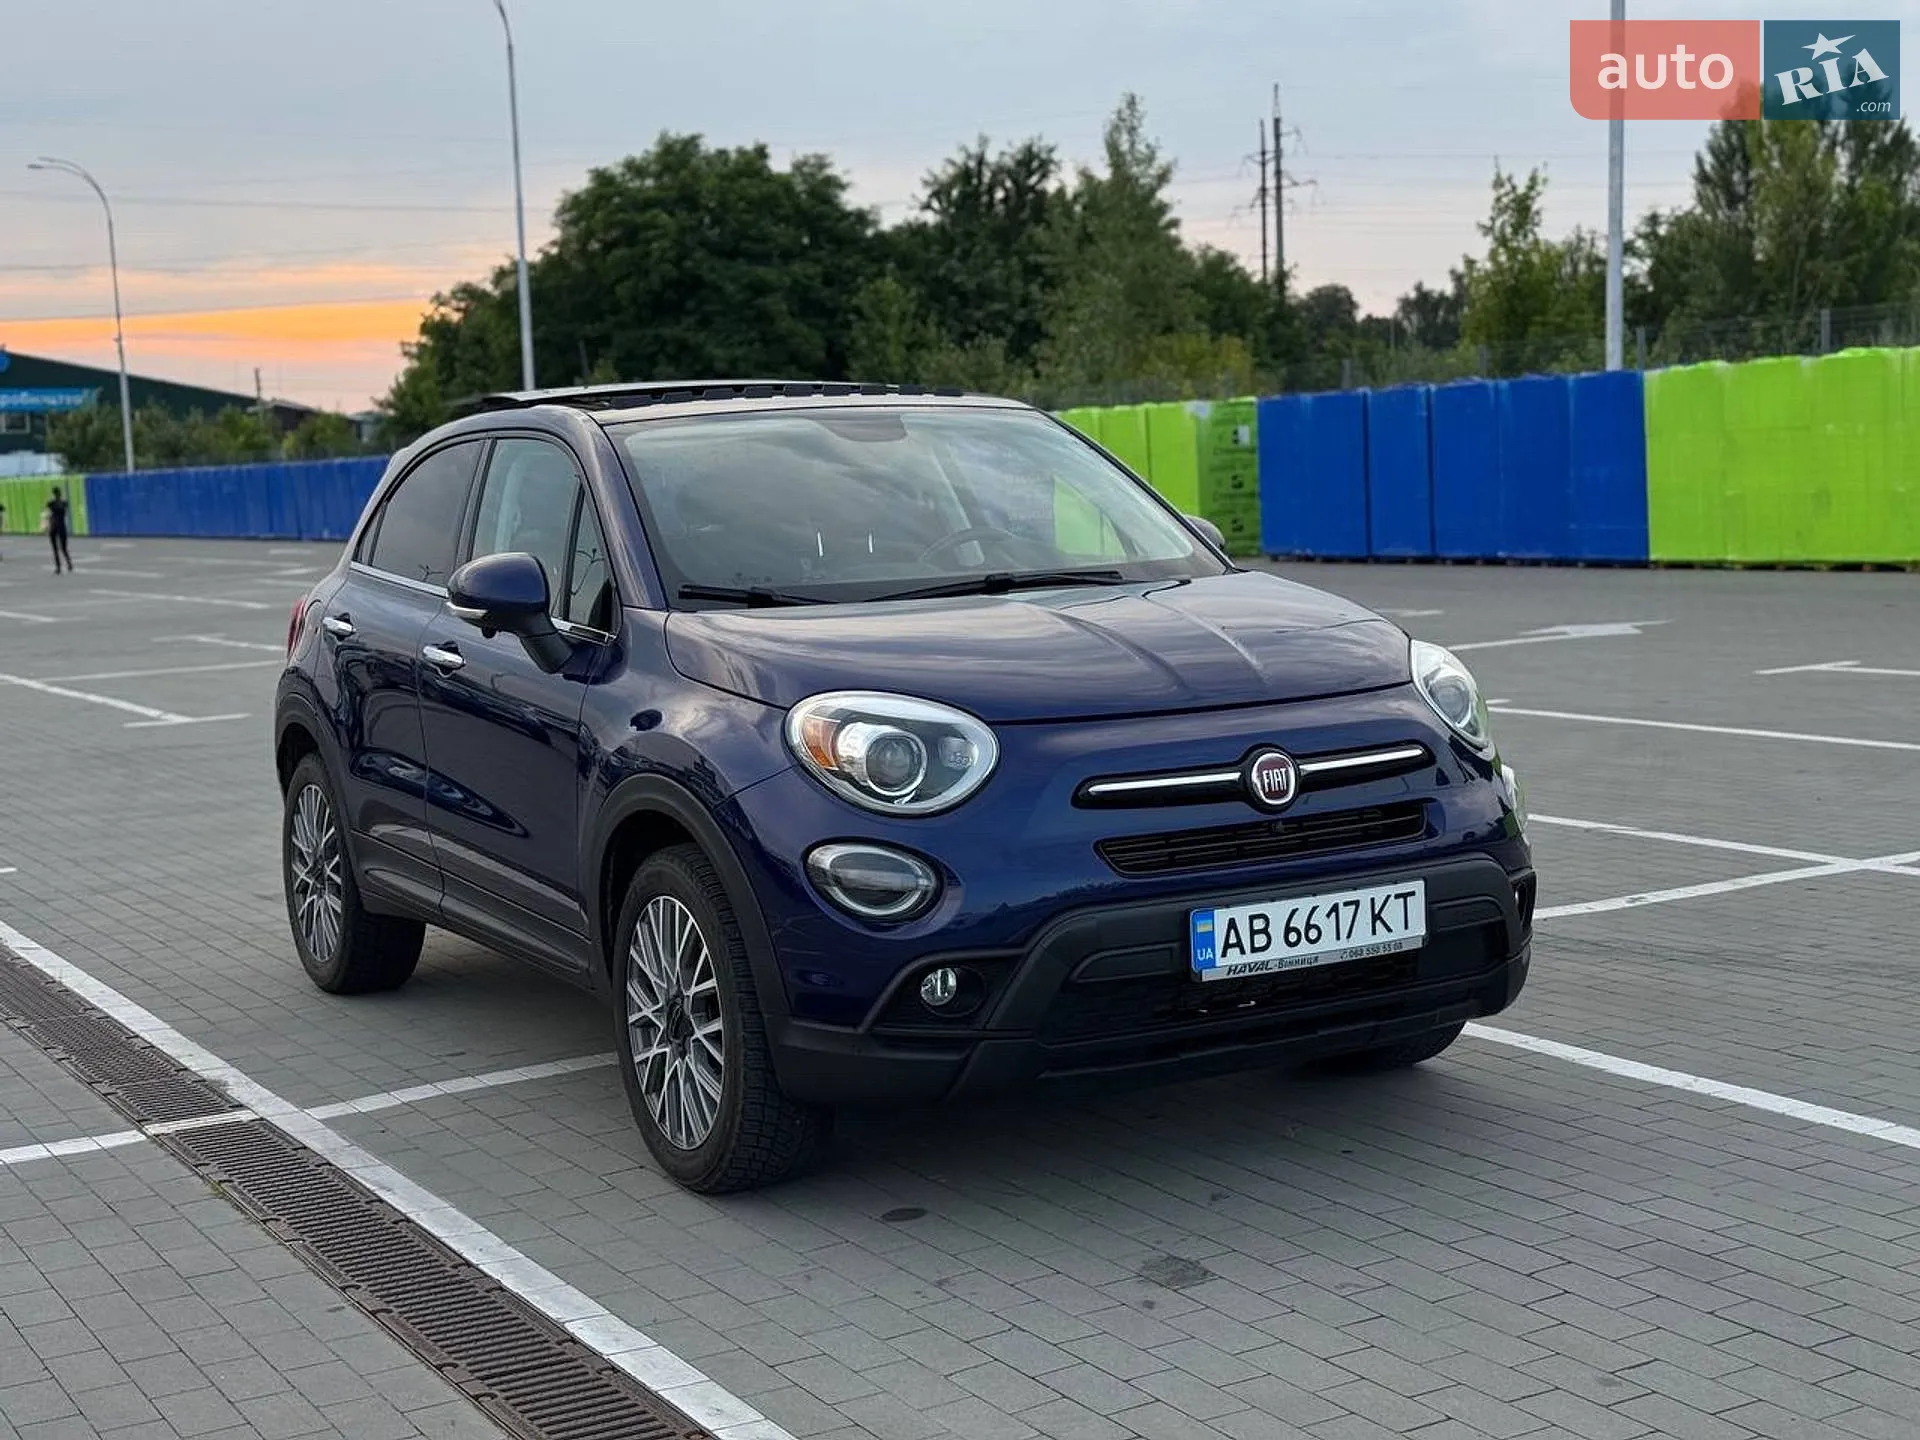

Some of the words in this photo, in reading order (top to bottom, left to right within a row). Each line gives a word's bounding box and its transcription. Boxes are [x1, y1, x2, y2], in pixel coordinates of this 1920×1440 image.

[1262, 767, 1287, 793] FIAT
[1221, 913, 1272, 958] AB
[1283, 899, 1360, 948] 6617
[1370, 891, 1416, 936] KT
[1198, 948, 1214, 961] UA
